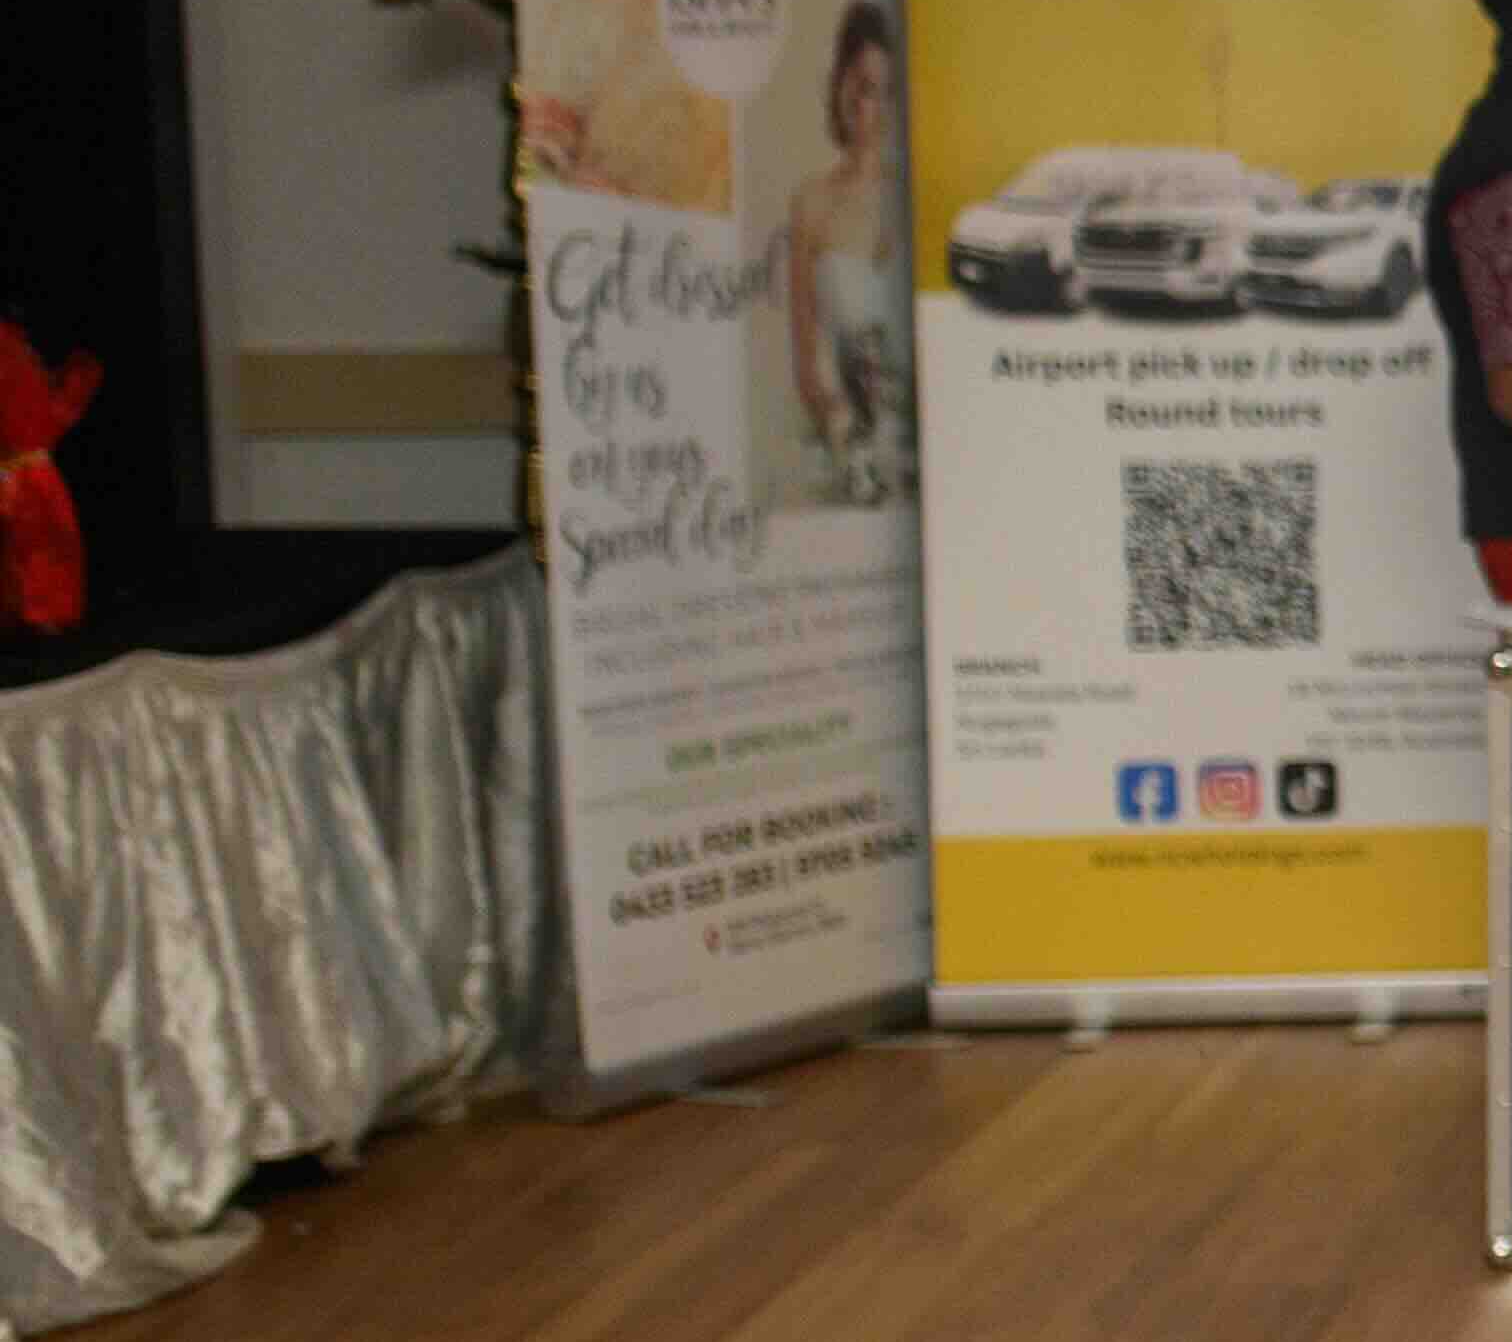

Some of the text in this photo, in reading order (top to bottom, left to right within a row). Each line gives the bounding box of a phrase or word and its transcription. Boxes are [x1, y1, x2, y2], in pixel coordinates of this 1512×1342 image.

[992, 348, 1118, 383] Airport
[1129, 349, 1202, 383] pick
[1211, 354, 1256, 383] up
[1294, 348, 1371, 383] drop
[1382, 347, 1433, 378] off
[1107, 398, 1325, 428] Round tours
[626, 835, 695, 878] CALL
[703, 816, 753, 854] FOR
